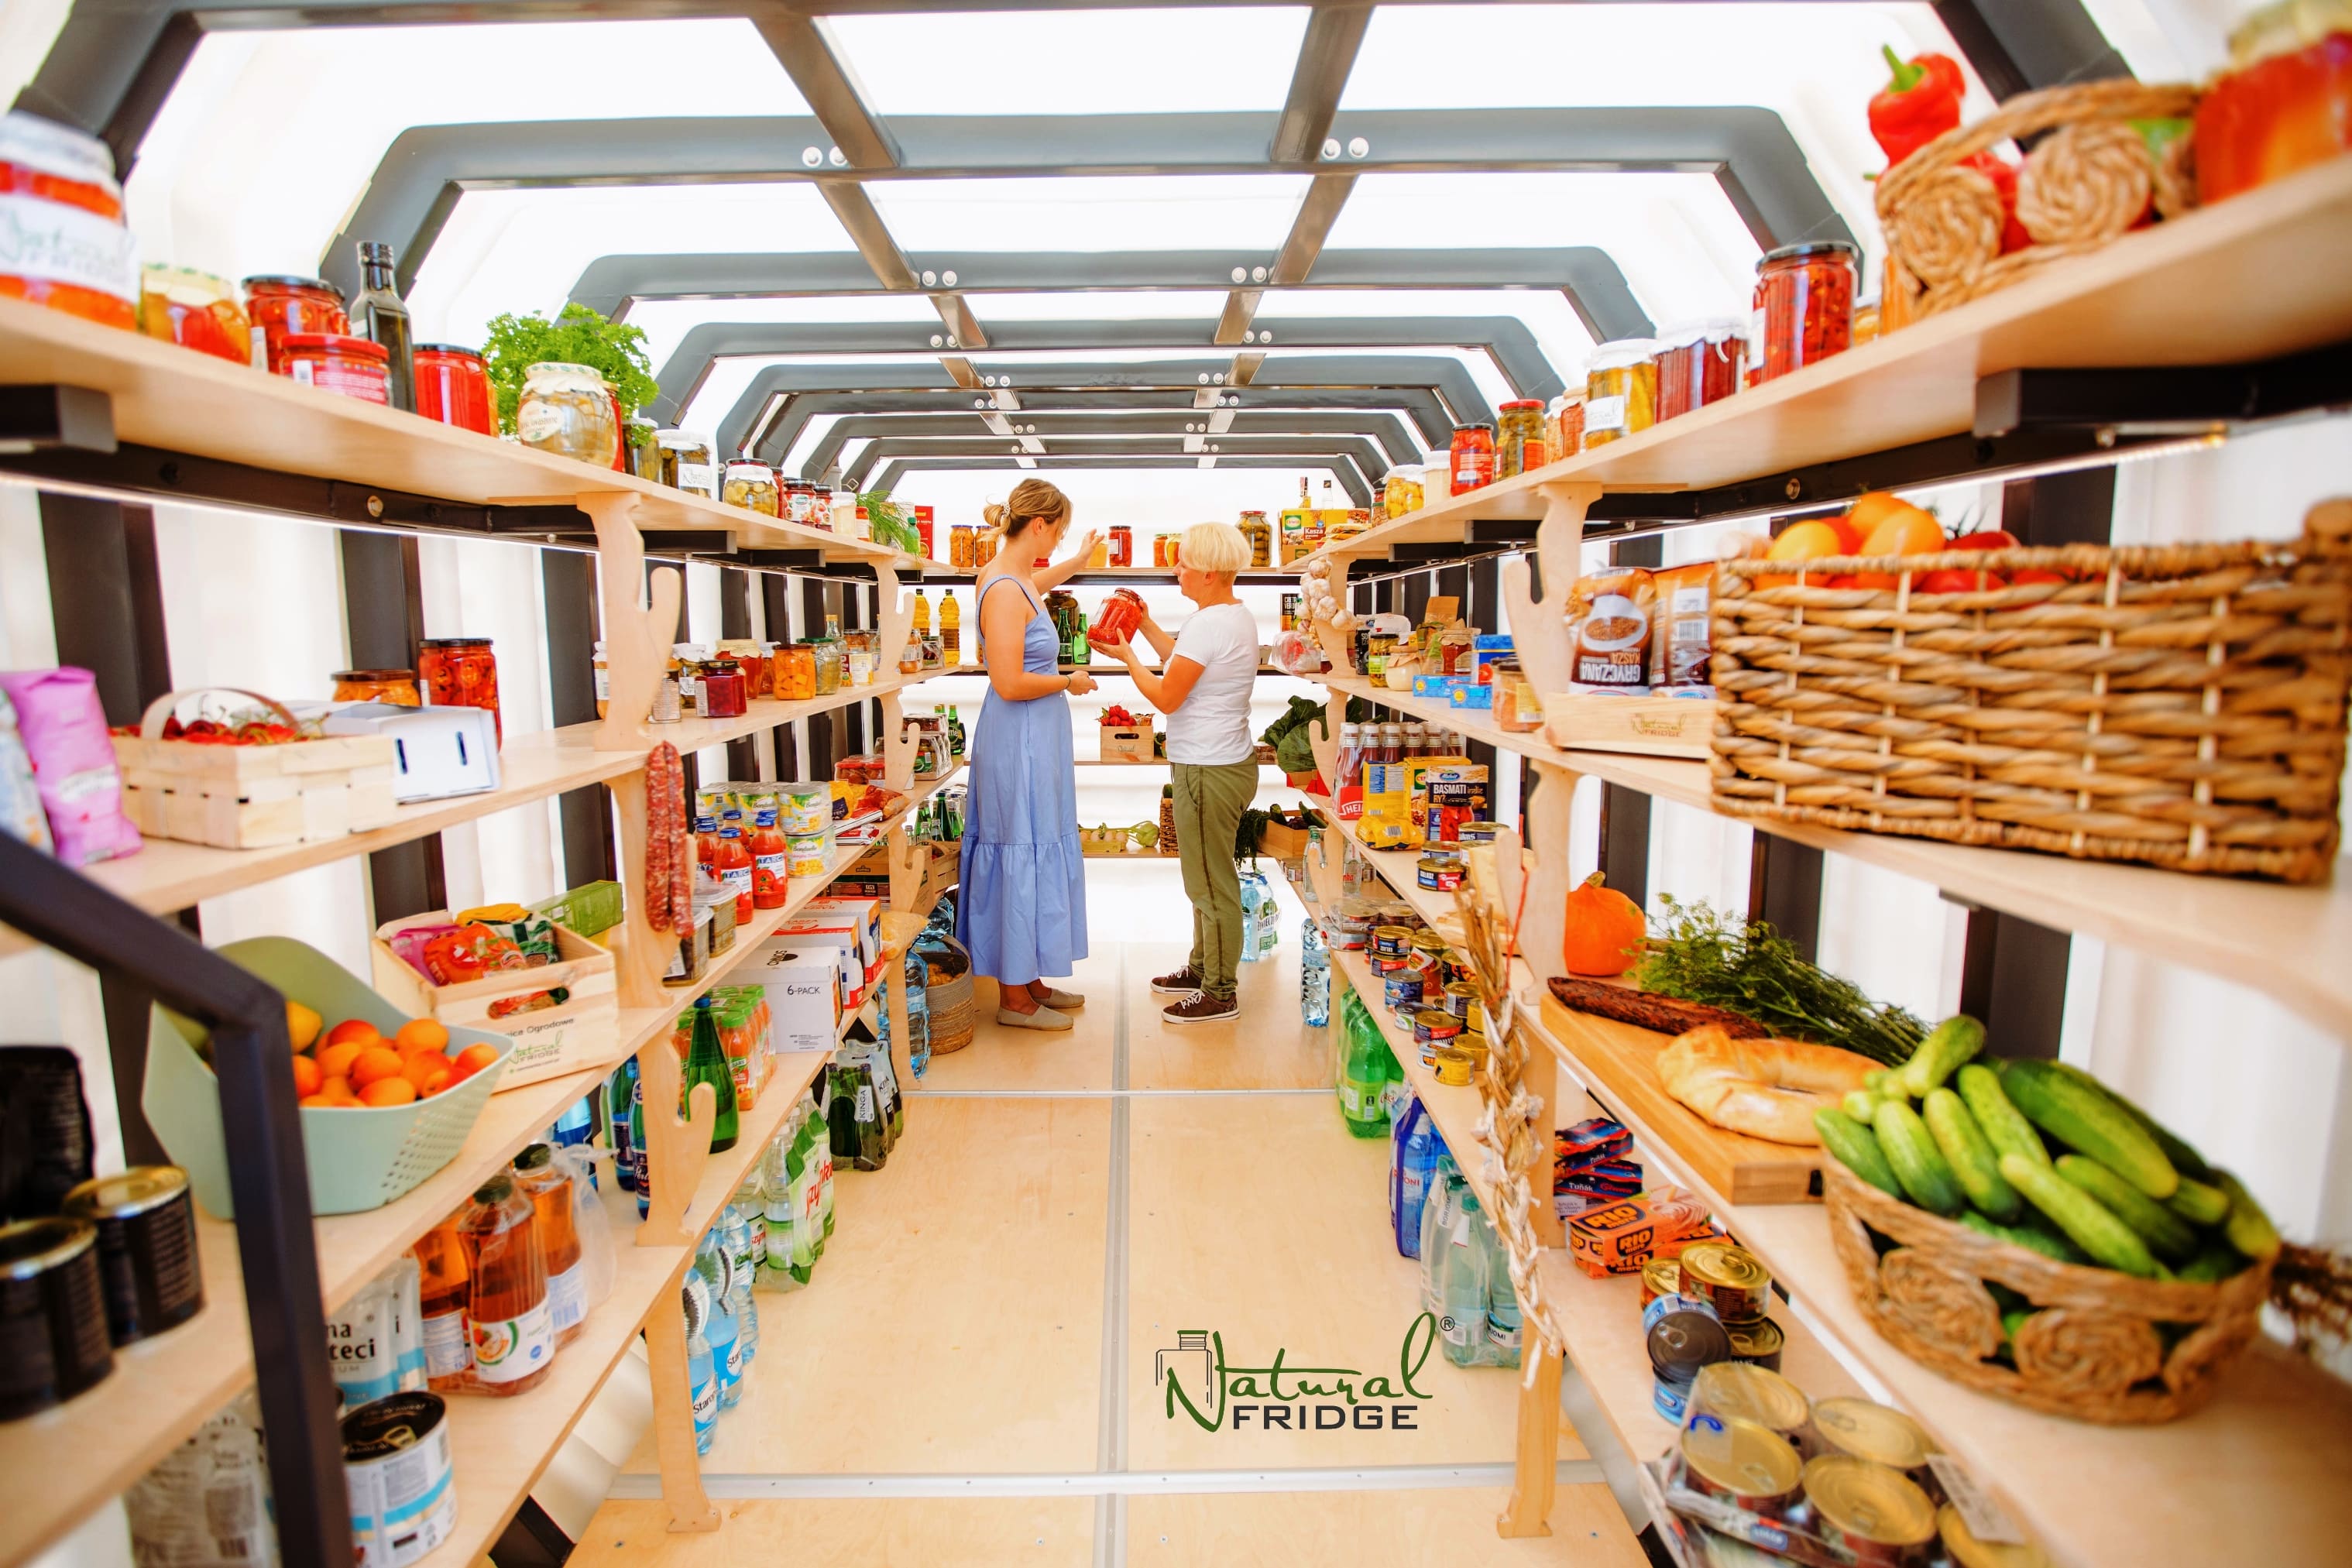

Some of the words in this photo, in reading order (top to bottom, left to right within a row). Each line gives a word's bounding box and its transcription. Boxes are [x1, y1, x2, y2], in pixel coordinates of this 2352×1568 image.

[1612, 652, 1641, 664] KASZA
[1580, 663, 1641, 682] GRYCZANA
[1434, 784, 1466, 794] BASMATI
[1346, 804, 1363, 814] HEI
[788, 985, 821, 995] 6-PACK
[527, 1017, 574, 1034] Ogrodowe
[1584, 1205, 1638, 1227] RIO
[1619, 1229, 1651, 1250] RIO
[330, 1338, 376, 1360] teci
